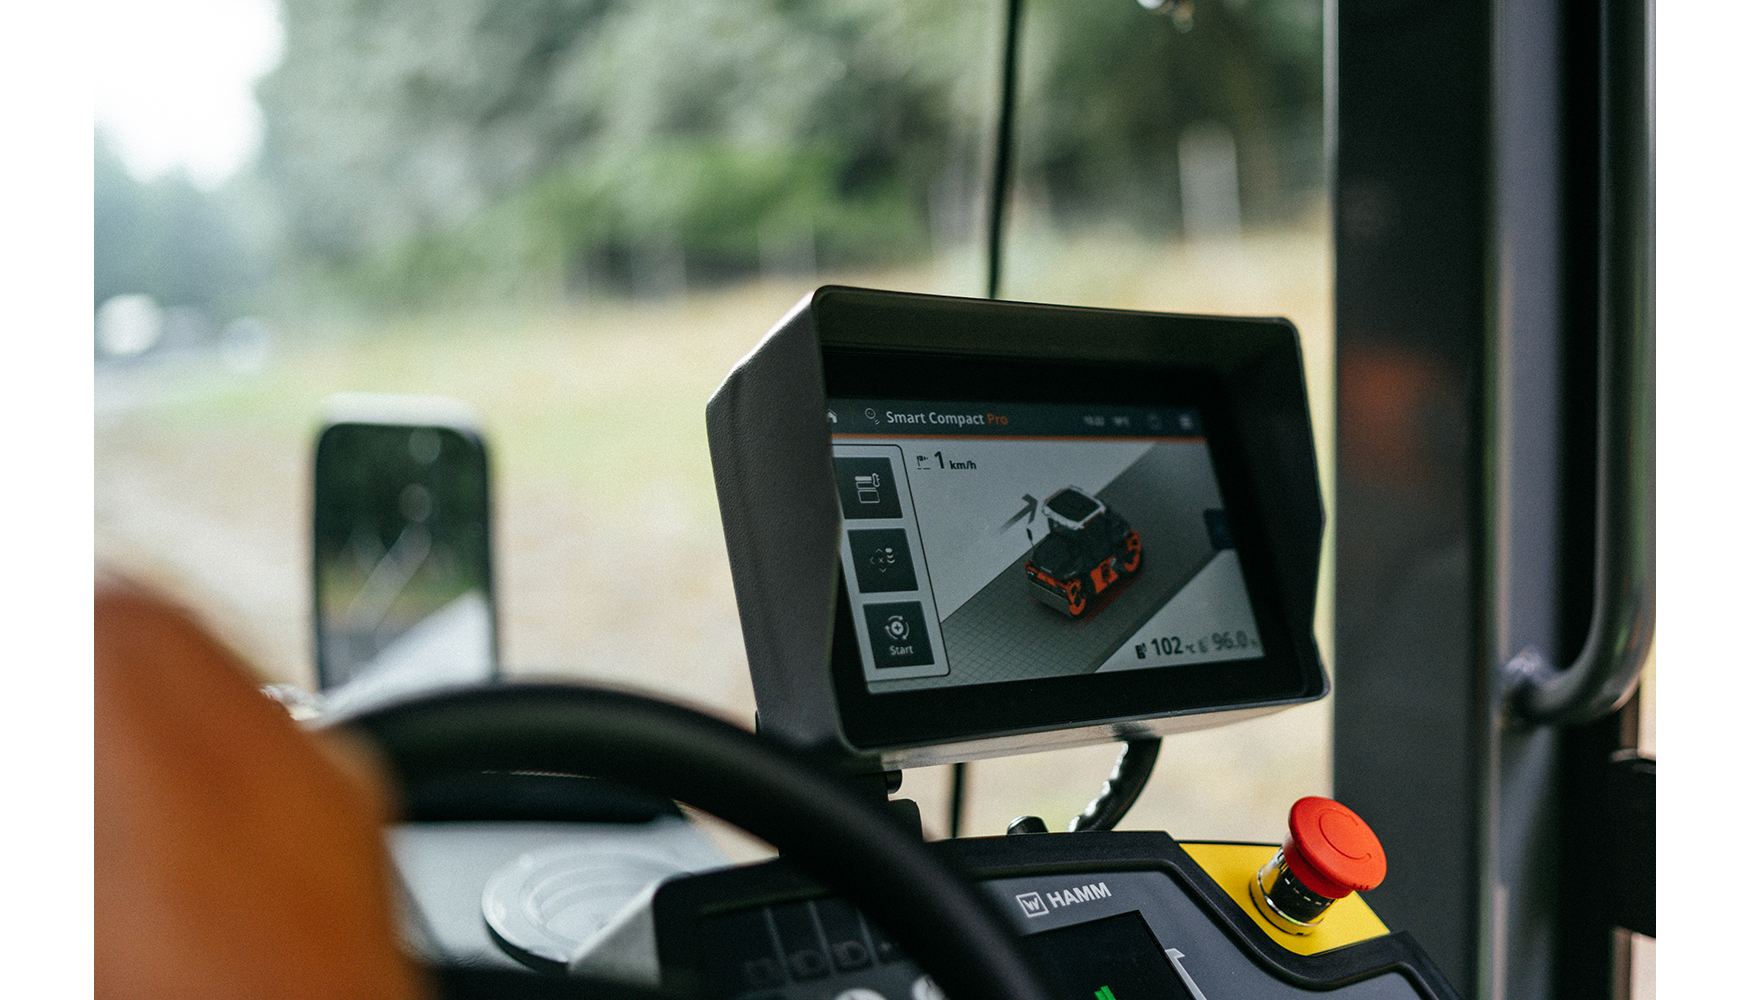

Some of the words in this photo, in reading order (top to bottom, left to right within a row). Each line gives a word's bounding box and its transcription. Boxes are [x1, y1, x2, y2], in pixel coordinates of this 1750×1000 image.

[886, 411, 926, 424] Smart
[929, 412, 985, 427] Compact
[987, 413, 1008, 425] Pro
[934, 451, 945, 469] 1
[950, 460, 977, 470] km/h
[890, 645, 914, 656] Start
[1151, 636, 1183, 656] 102
[1046, 882, 1112, 908] HAMM
